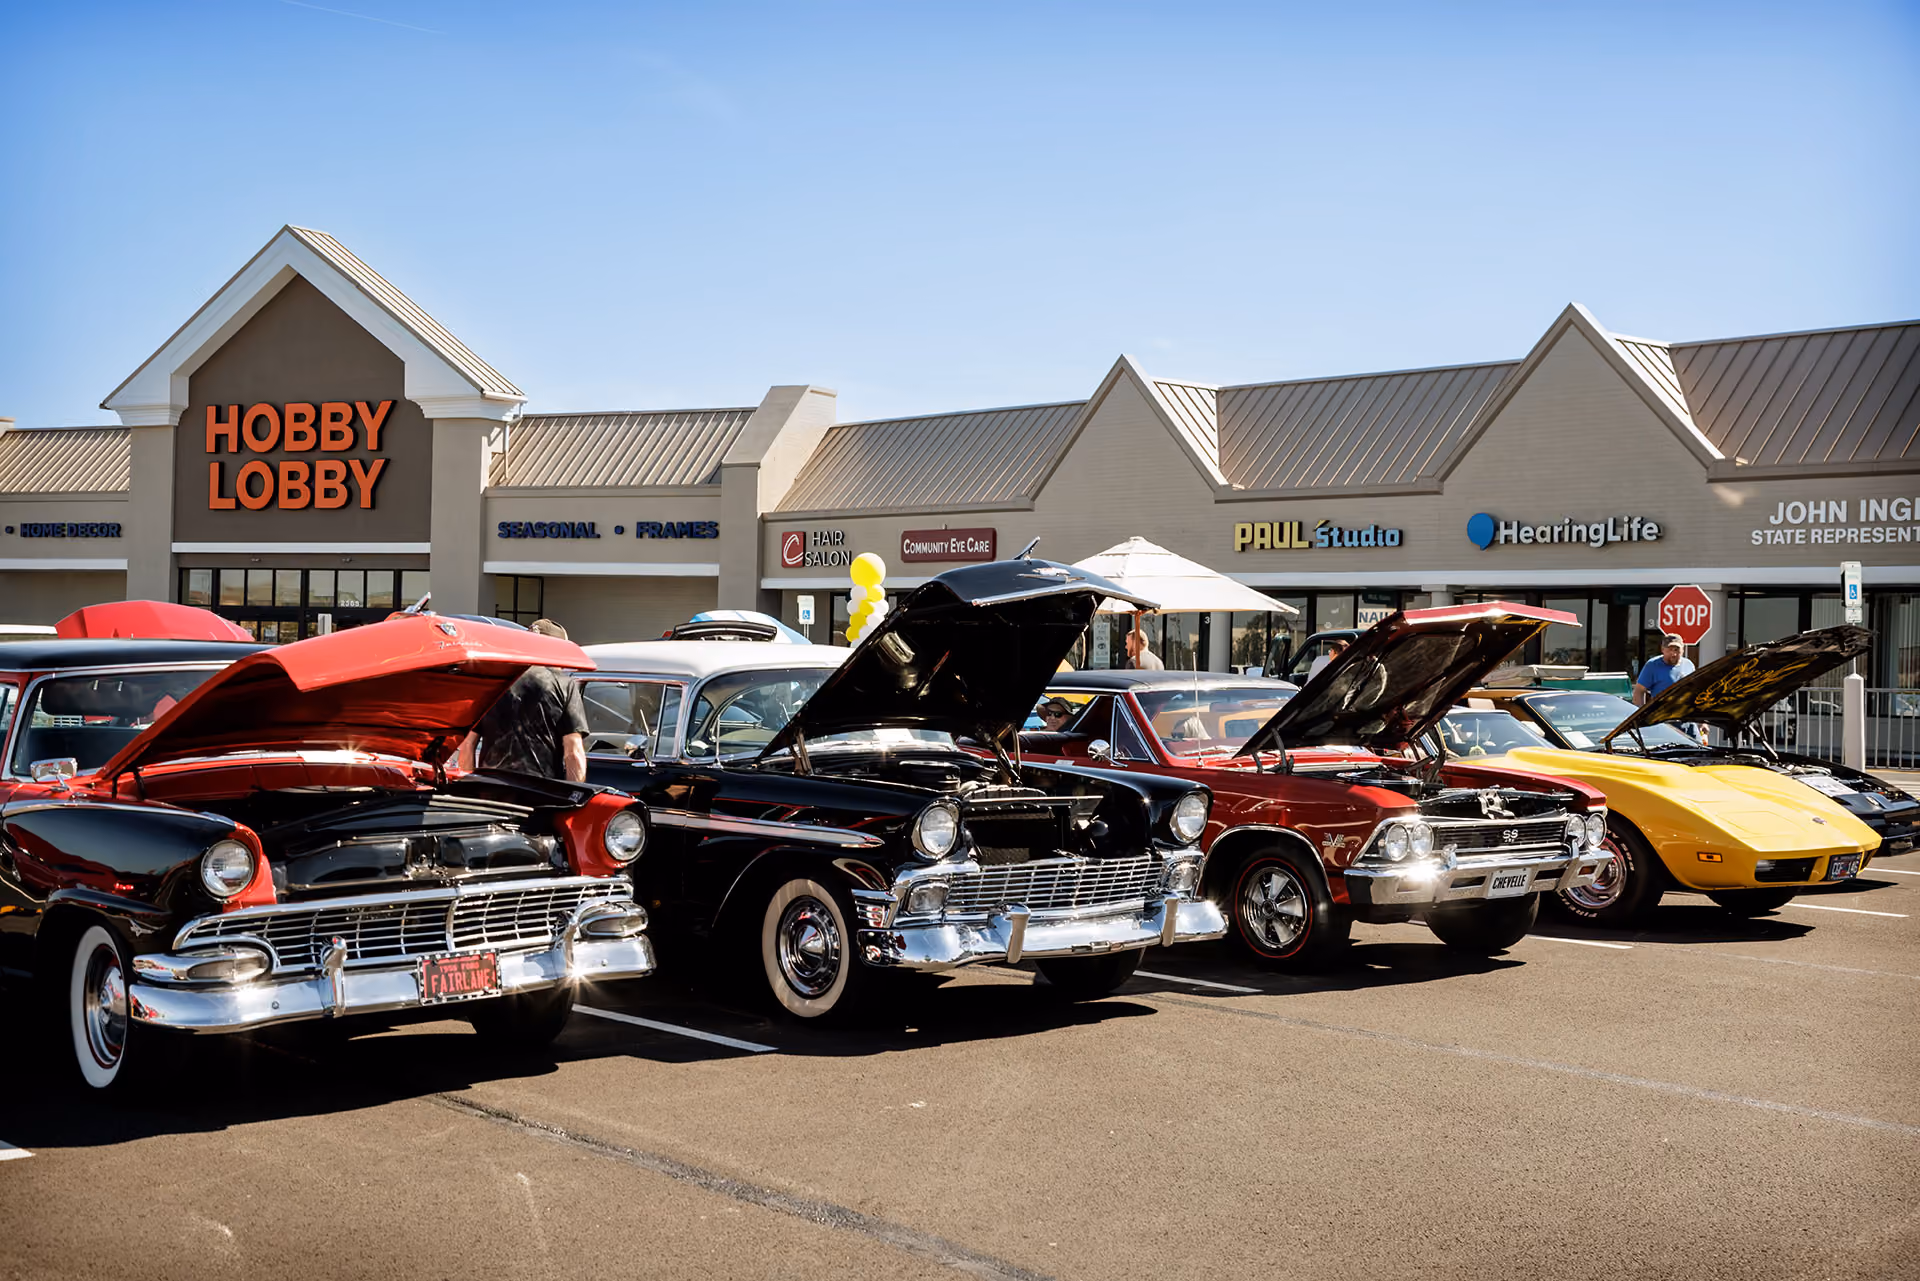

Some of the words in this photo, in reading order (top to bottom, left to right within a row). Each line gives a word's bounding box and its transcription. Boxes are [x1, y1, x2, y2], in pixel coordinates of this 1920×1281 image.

[206, 400, 394, 453] HOBBY
[209, 458, 388, 510] LOBBY
[1769, 500, 1848, 525] JOHN
[21, 523, 66, 537] HOME
[66, 523, 121, 537] DECOR
[498, 521, 600, 539] SEASONAL
[636, 521, 719, 539] FRAMES
[812, 531, 844, 546] HAIR
[1234, 521, 1312, 551] PAUL
[1500, 515, 1660, 548] HearingLife
[1751, 529, 1807, 545] STATE
[950, 537, 966, 552] EYE
[967, 537, 990, 552] CARE
[805, 551, 851, 566] SALON
[1663, 604, 1708, 626] STOP
[1503, 829, 1518, 839] SS
[1492, 875, 1527, 889] CHEVELLE
